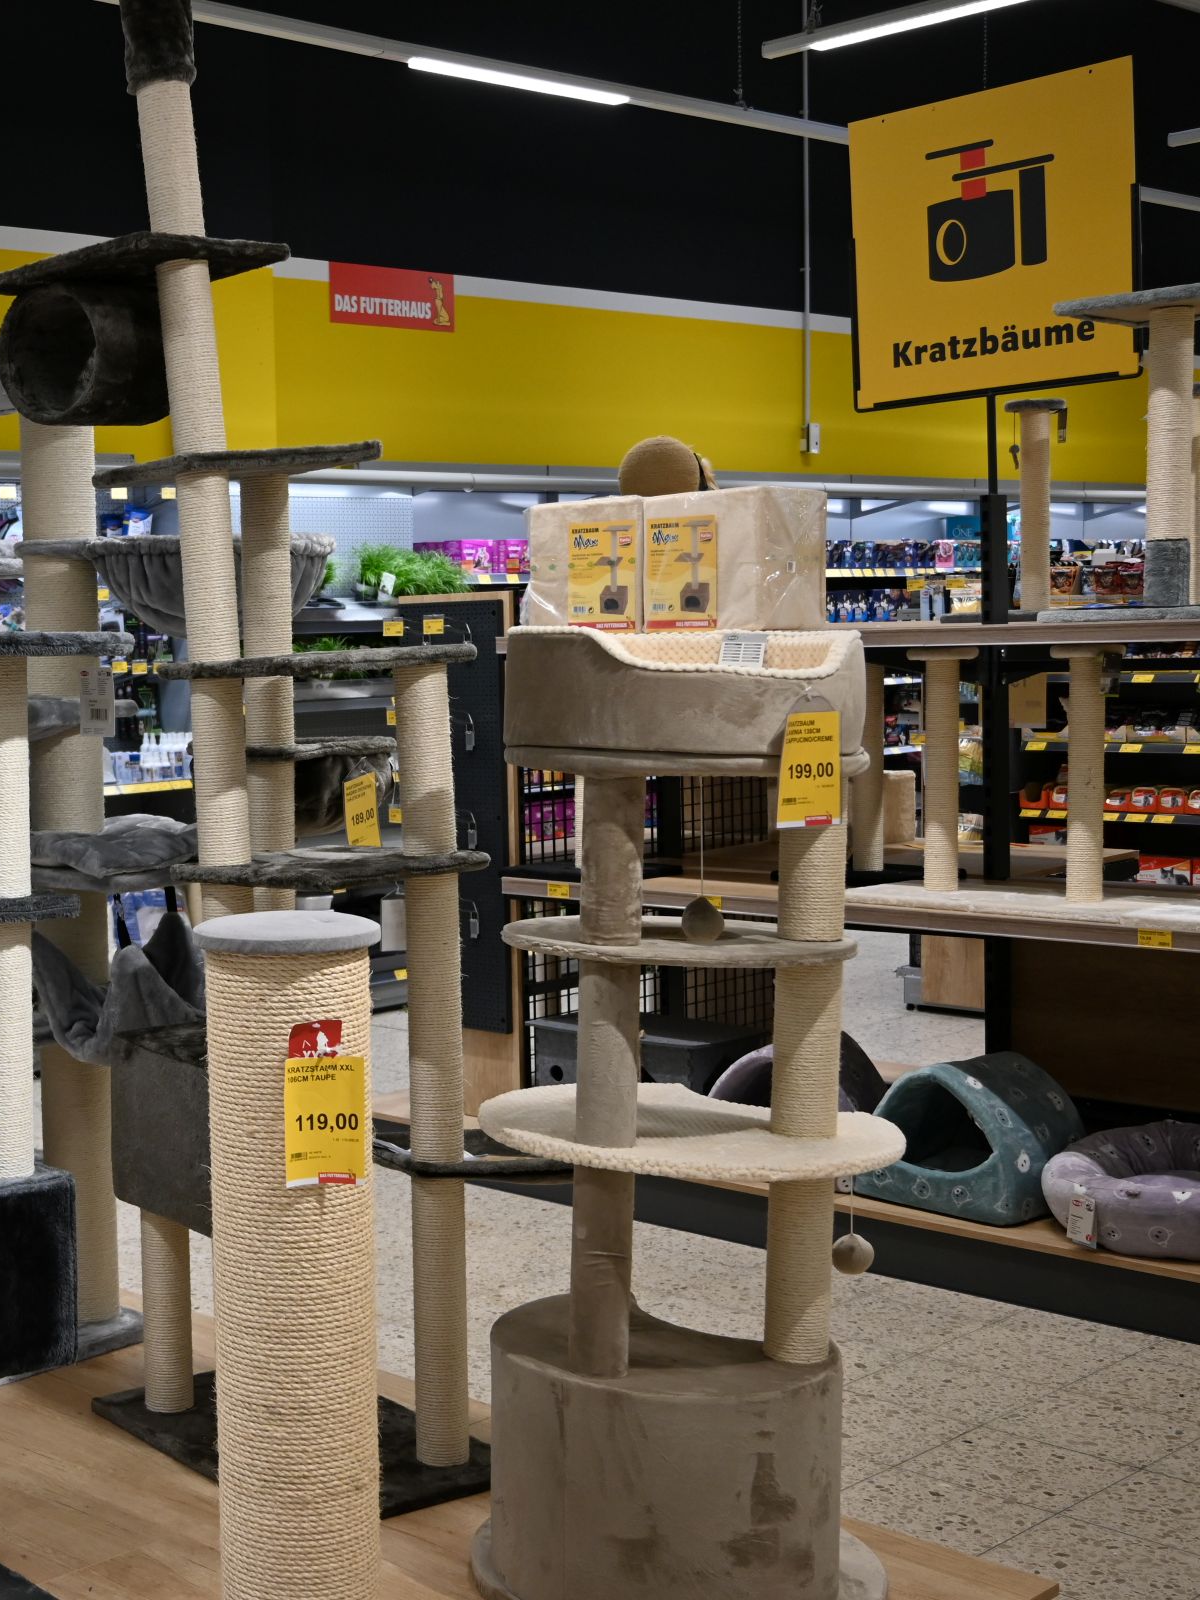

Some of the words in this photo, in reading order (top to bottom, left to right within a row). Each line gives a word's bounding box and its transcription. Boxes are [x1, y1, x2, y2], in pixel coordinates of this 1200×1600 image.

[334, 293, 357, 313] DAS
[360, 296, 432, 320] FUTTERHAUS
[893, 319, 1096, 368] Kratzbäume
[788, 762, 834, 780] 199,00
[351, 808, 374, 826] 189,00
[287, 1065, 337, 1073] KRATZSTAMM
[295, 1113, 359, 1132] 119,00
